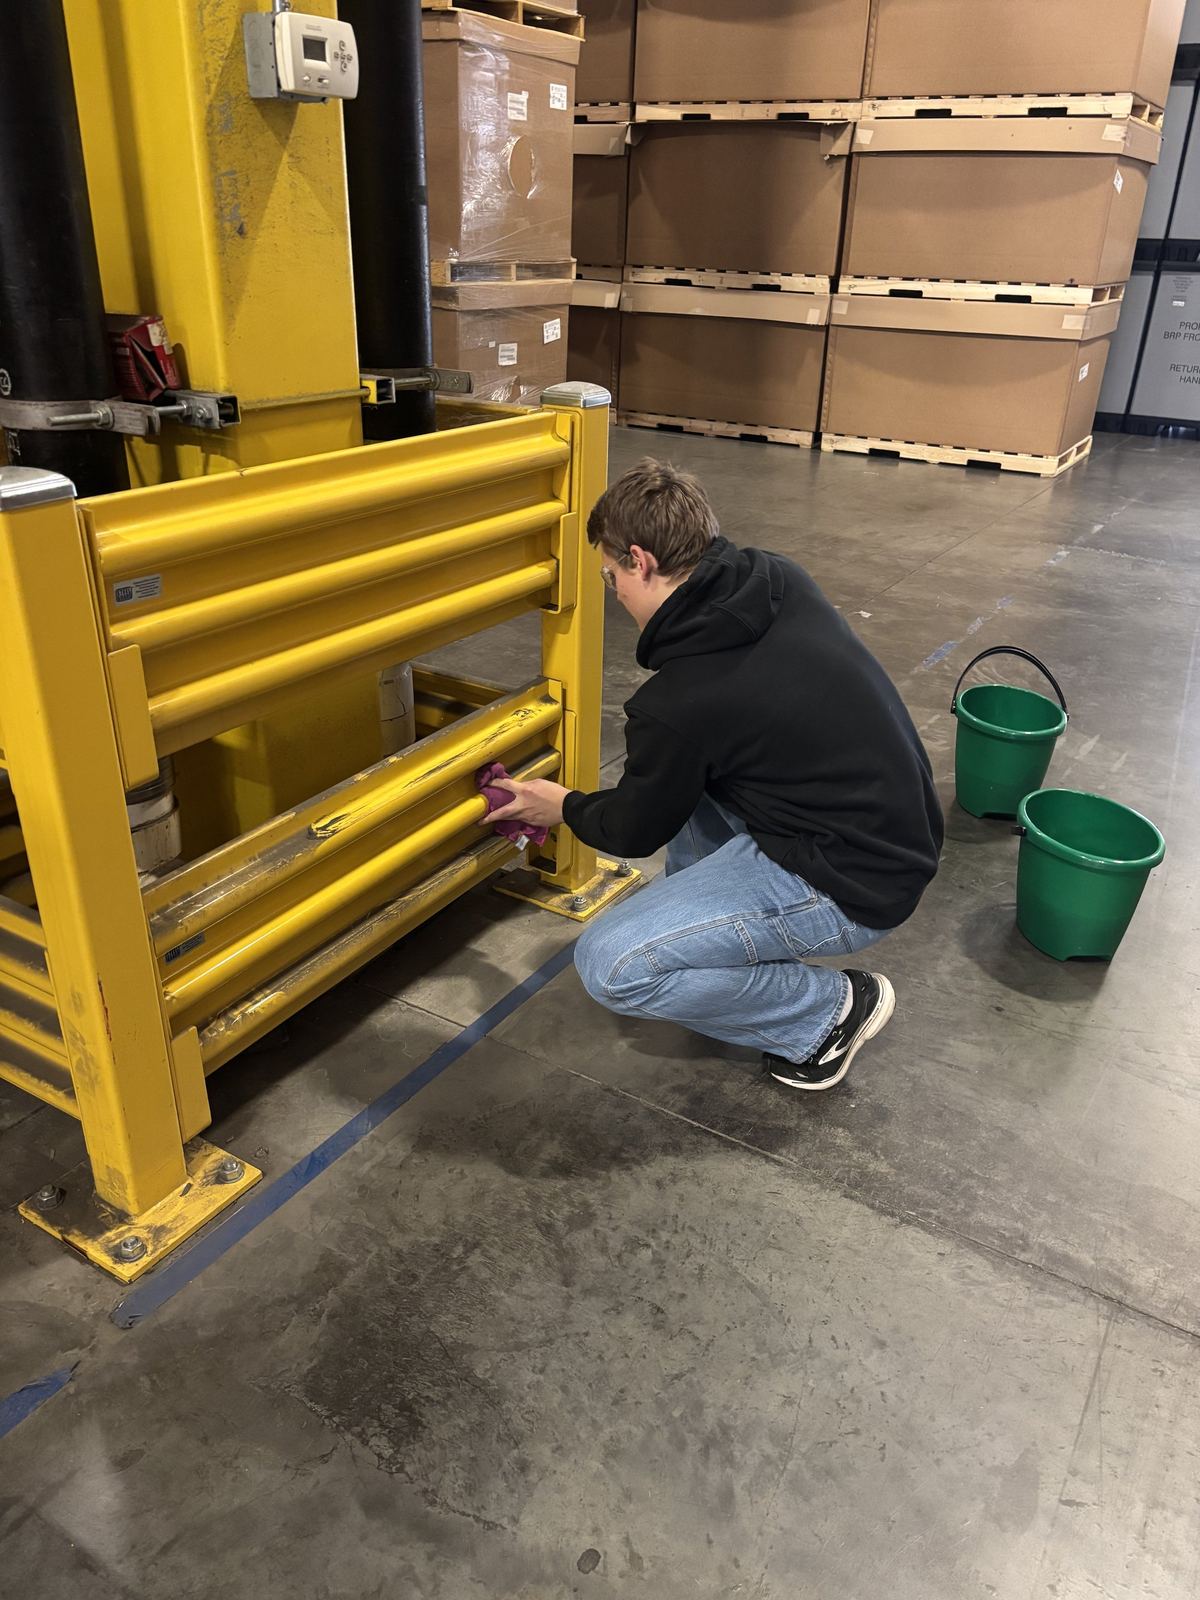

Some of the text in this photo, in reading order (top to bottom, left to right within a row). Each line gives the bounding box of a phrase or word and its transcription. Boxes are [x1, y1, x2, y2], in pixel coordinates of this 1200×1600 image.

[1179, 321, 1200, 331] PRO
[1170, 363, 1200, 374] RETUR
[1179, 375, 1200, 385] HAN
